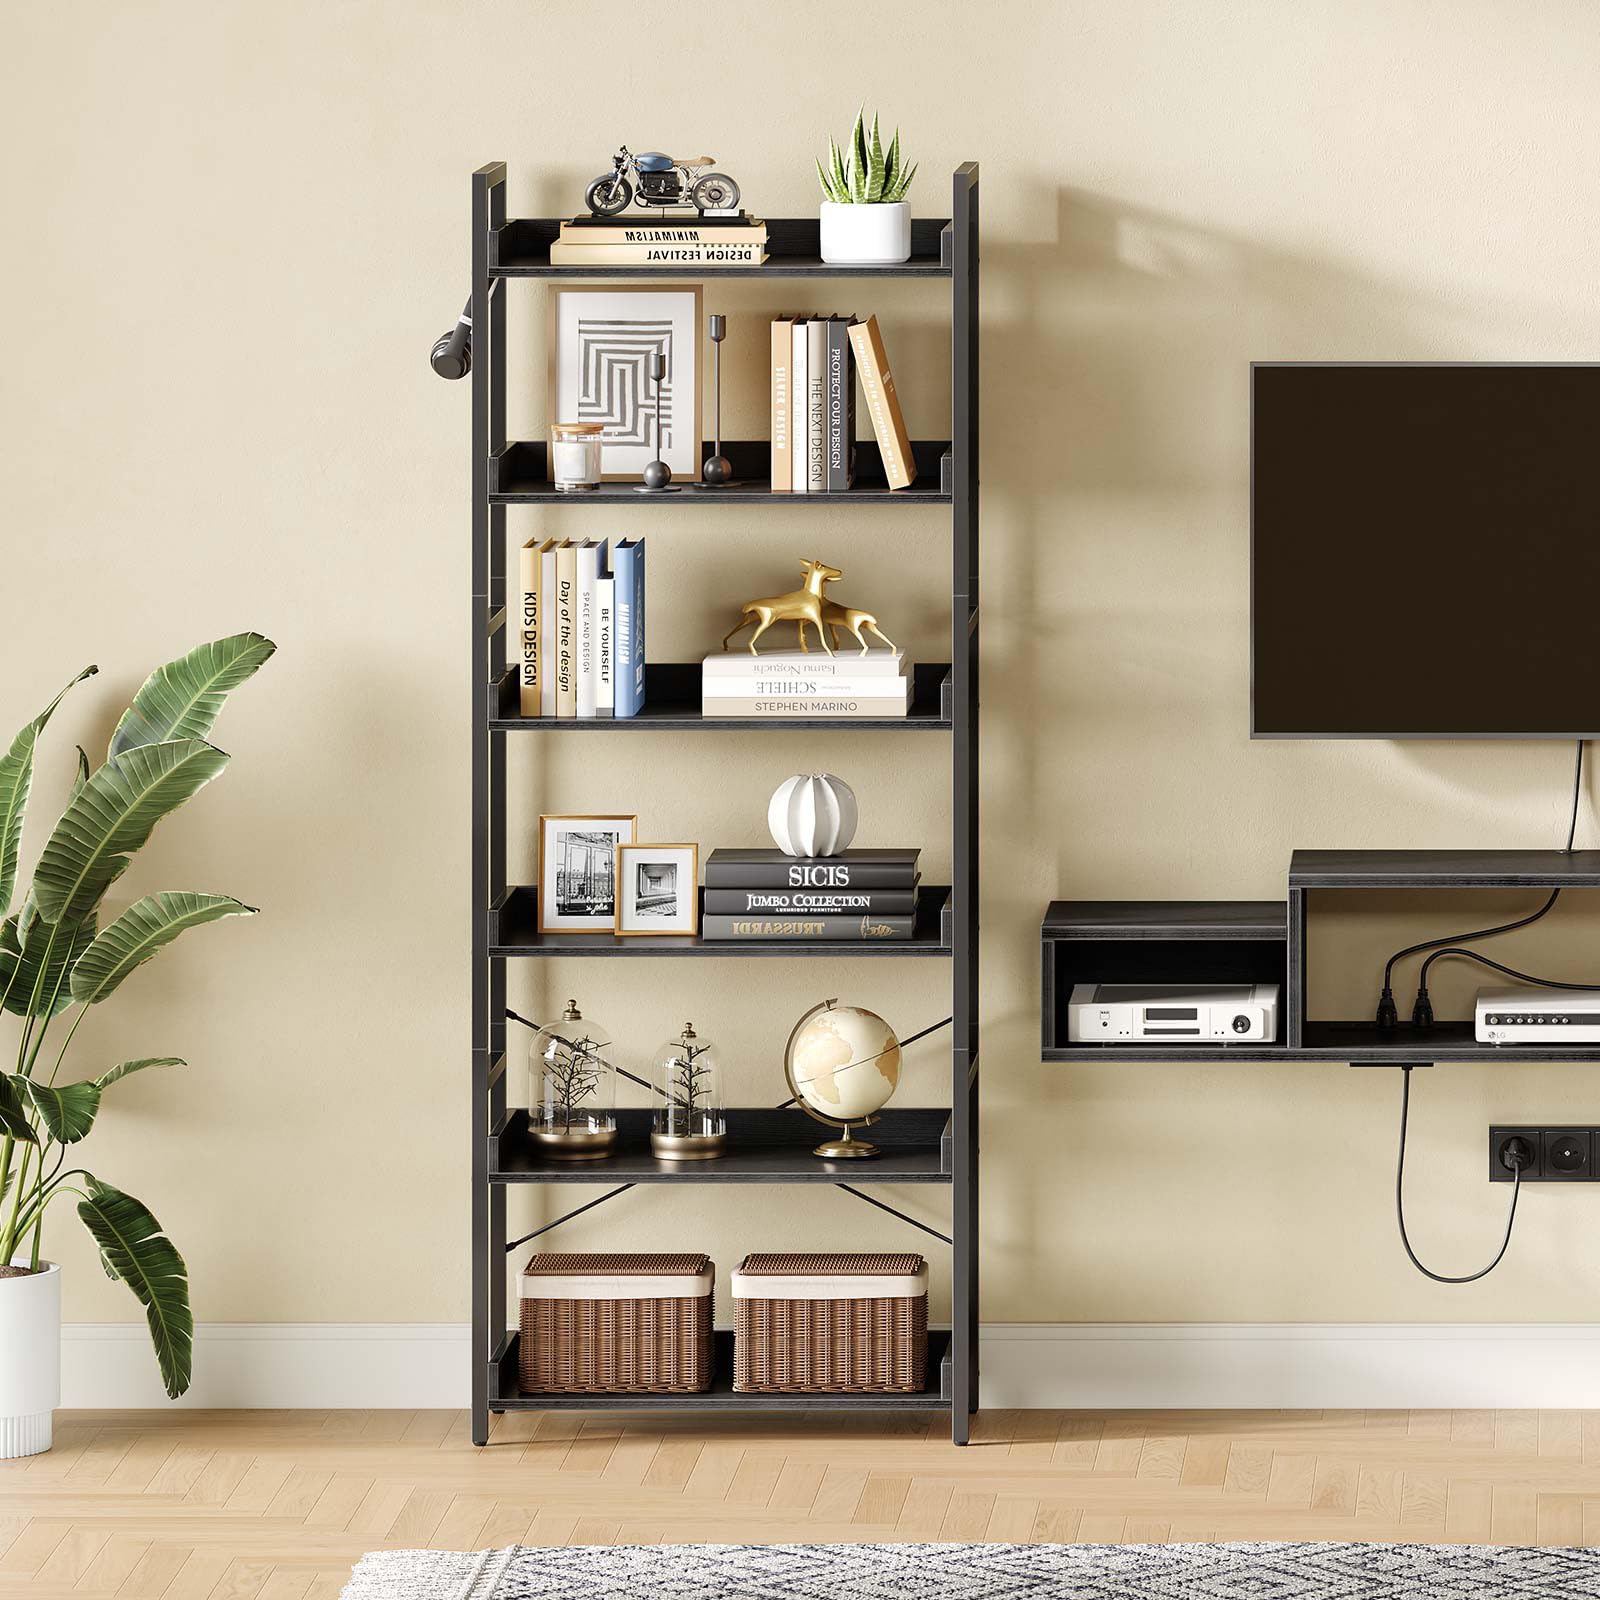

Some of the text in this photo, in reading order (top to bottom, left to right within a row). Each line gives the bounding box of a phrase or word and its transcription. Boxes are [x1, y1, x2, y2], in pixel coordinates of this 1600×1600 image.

[775, 366, 786, 449] SILVER DESIGN
[811, 376, 823, 482] THE NEXT DESIGN
[831, 348, 841, 469] PROTECT OUR DESIGN
[524, 592, 537, 686] KIDS DESIGN
[559, 581, 571, 692] Day of the design
[582, 592, 590, 673] SPACE AND DESIGN
[601, 608, 609, 684] BE YOURSELF
[753, 663, 836, 675] Isamu Noguchi
[755, 702, 858, 712] STEPHEN MARINO
[756, 681, 817, 694] SCHIELE
[788, 865, 850, 887] SICIS
